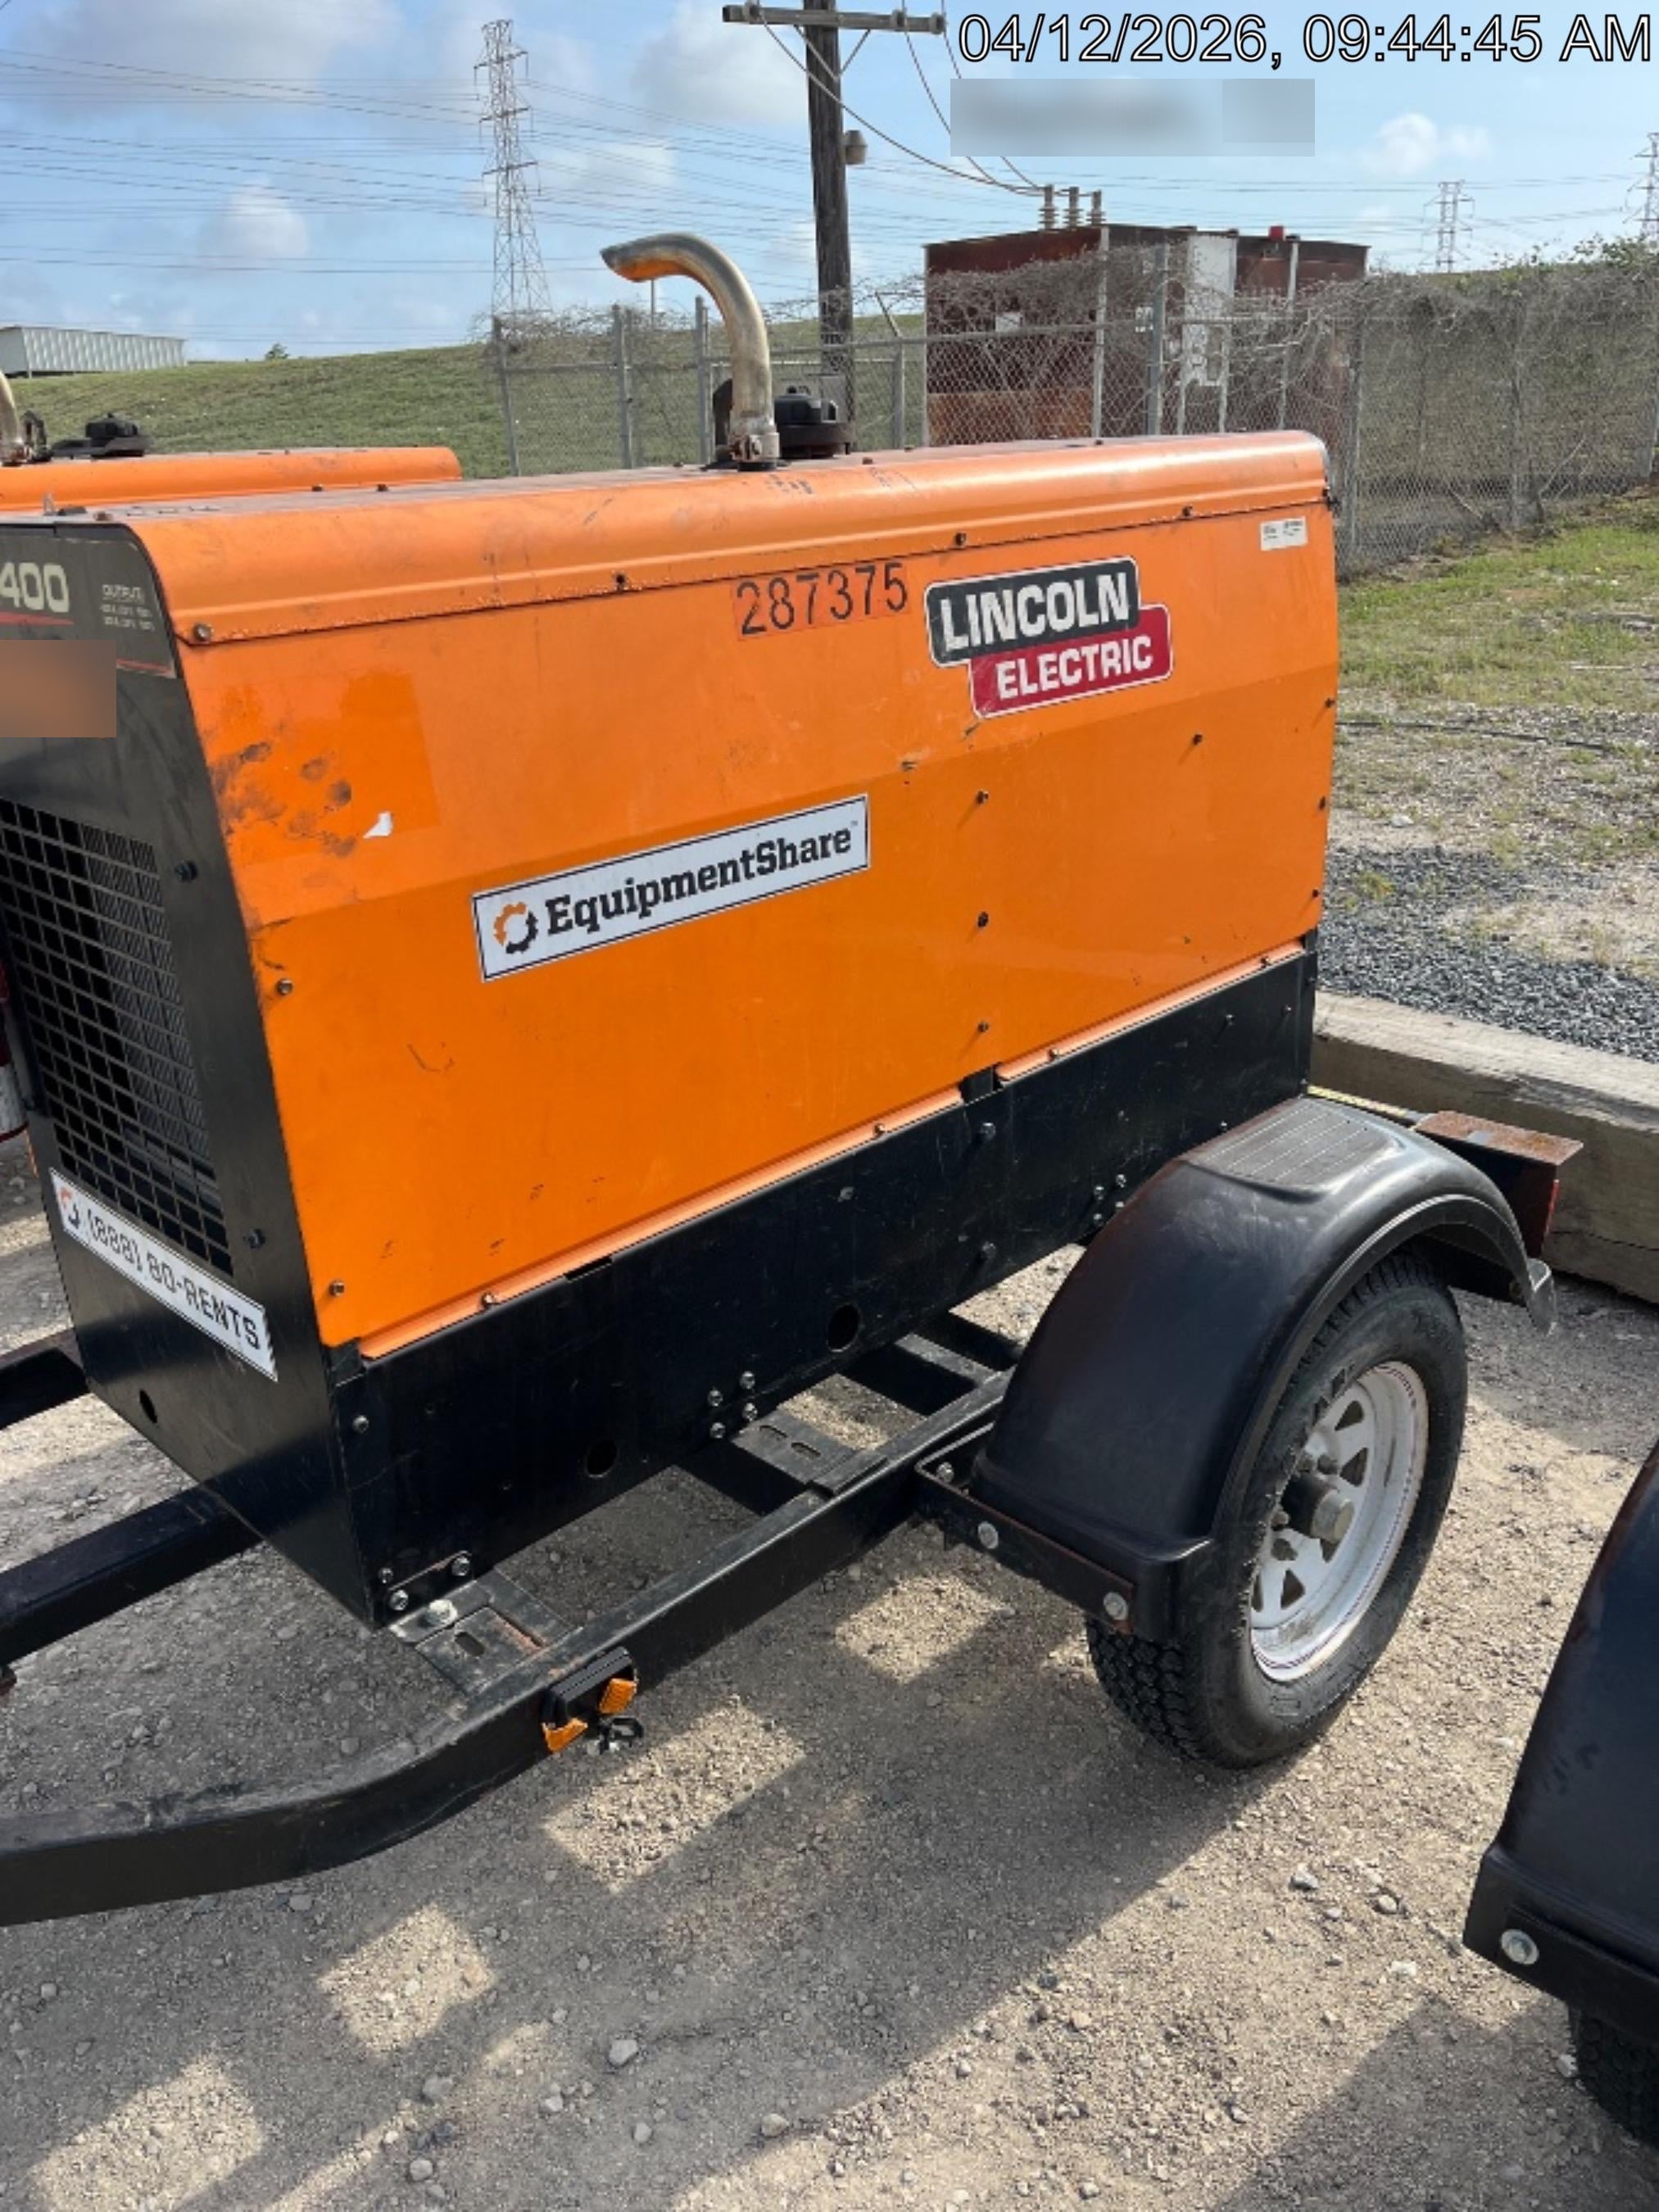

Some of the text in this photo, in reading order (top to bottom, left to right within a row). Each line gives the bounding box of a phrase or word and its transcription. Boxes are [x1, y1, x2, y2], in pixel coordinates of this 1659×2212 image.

[736, 561, 909, 636] 287375
[939, 572, 1130, 654] LINCOLN
[995, 634, 1153, 700] ELECTRIC
[545, 826, 852, 935] EquipmentShare
[87, 1208, 261, 1351] (888) 80-RENTS
